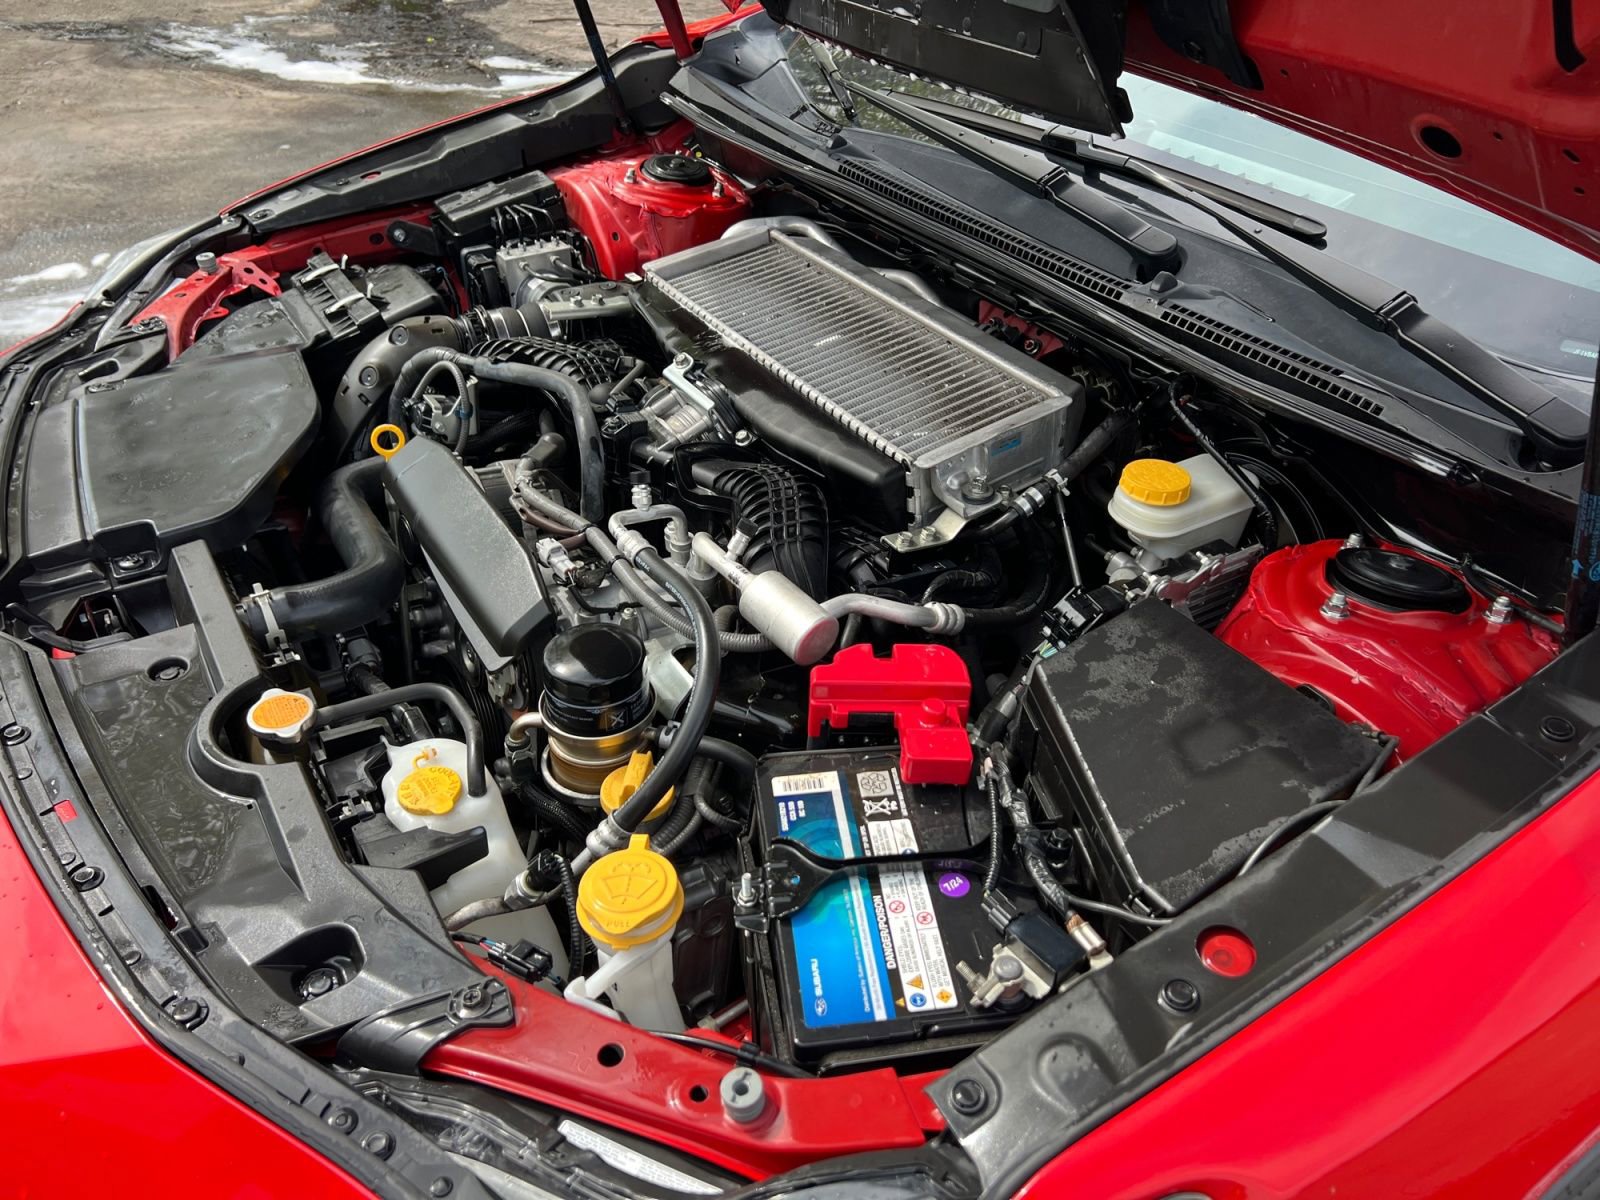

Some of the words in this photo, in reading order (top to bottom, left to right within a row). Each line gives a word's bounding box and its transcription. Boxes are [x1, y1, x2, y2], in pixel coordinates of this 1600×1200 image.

[606, 918, 631, 929] PULL
[872, 895, 897, 970] DANGER/POISON
[811, 958, 823, 996] SUBARU
